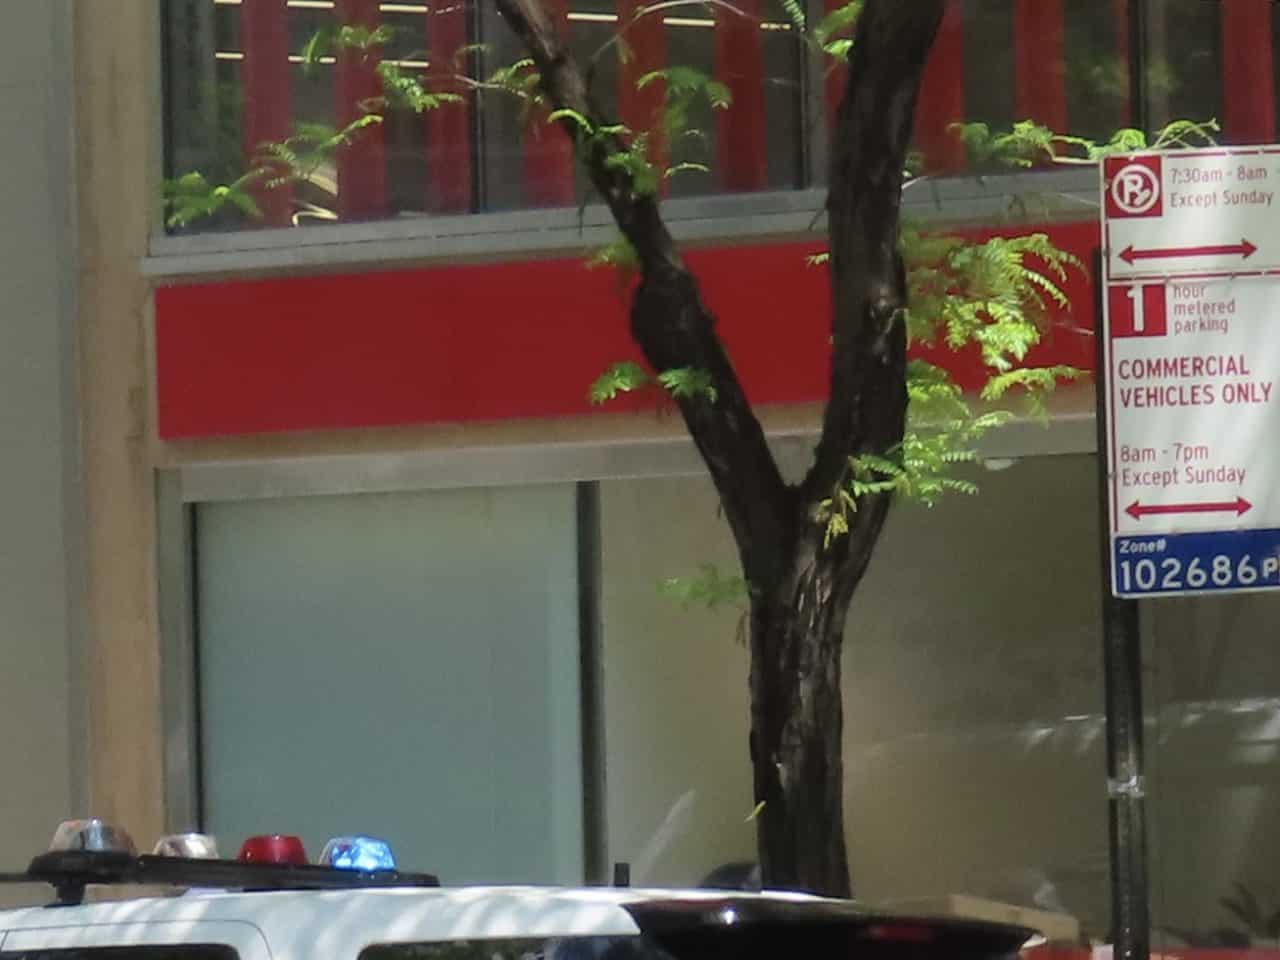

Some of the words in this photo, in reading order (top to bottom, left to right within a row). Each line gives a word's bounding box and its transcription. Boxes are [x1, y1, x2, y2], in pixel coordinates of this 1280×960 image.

[1171, 167, 1222, 184] 7:30am
[1237, 164, 1268, 181] 8am
[1170, 191, 1217, 209] Except
[1223, 188, 1273, 207] Sunday
[1126, 284, 1144, 333] 1
[1173, 284, 1207, 299] hour
[1173, 299, 1236, 316] metered
[1173, 316, 1229, 335] parking
[1118, 354, 1251, 381] COMMERCIAL
[1120, 384, 1215, 409] VEHICLES
[1222, 382, 1272, 405] ONLY
[1120, 446, 1156, 463] 8am
[1173, 443, 1209, 463] 7pm
[1122, 469, 1179, 489] Except
[1185, 465, 1246, 486] Sunday
[1120, 554, 1258, 592] 102686
